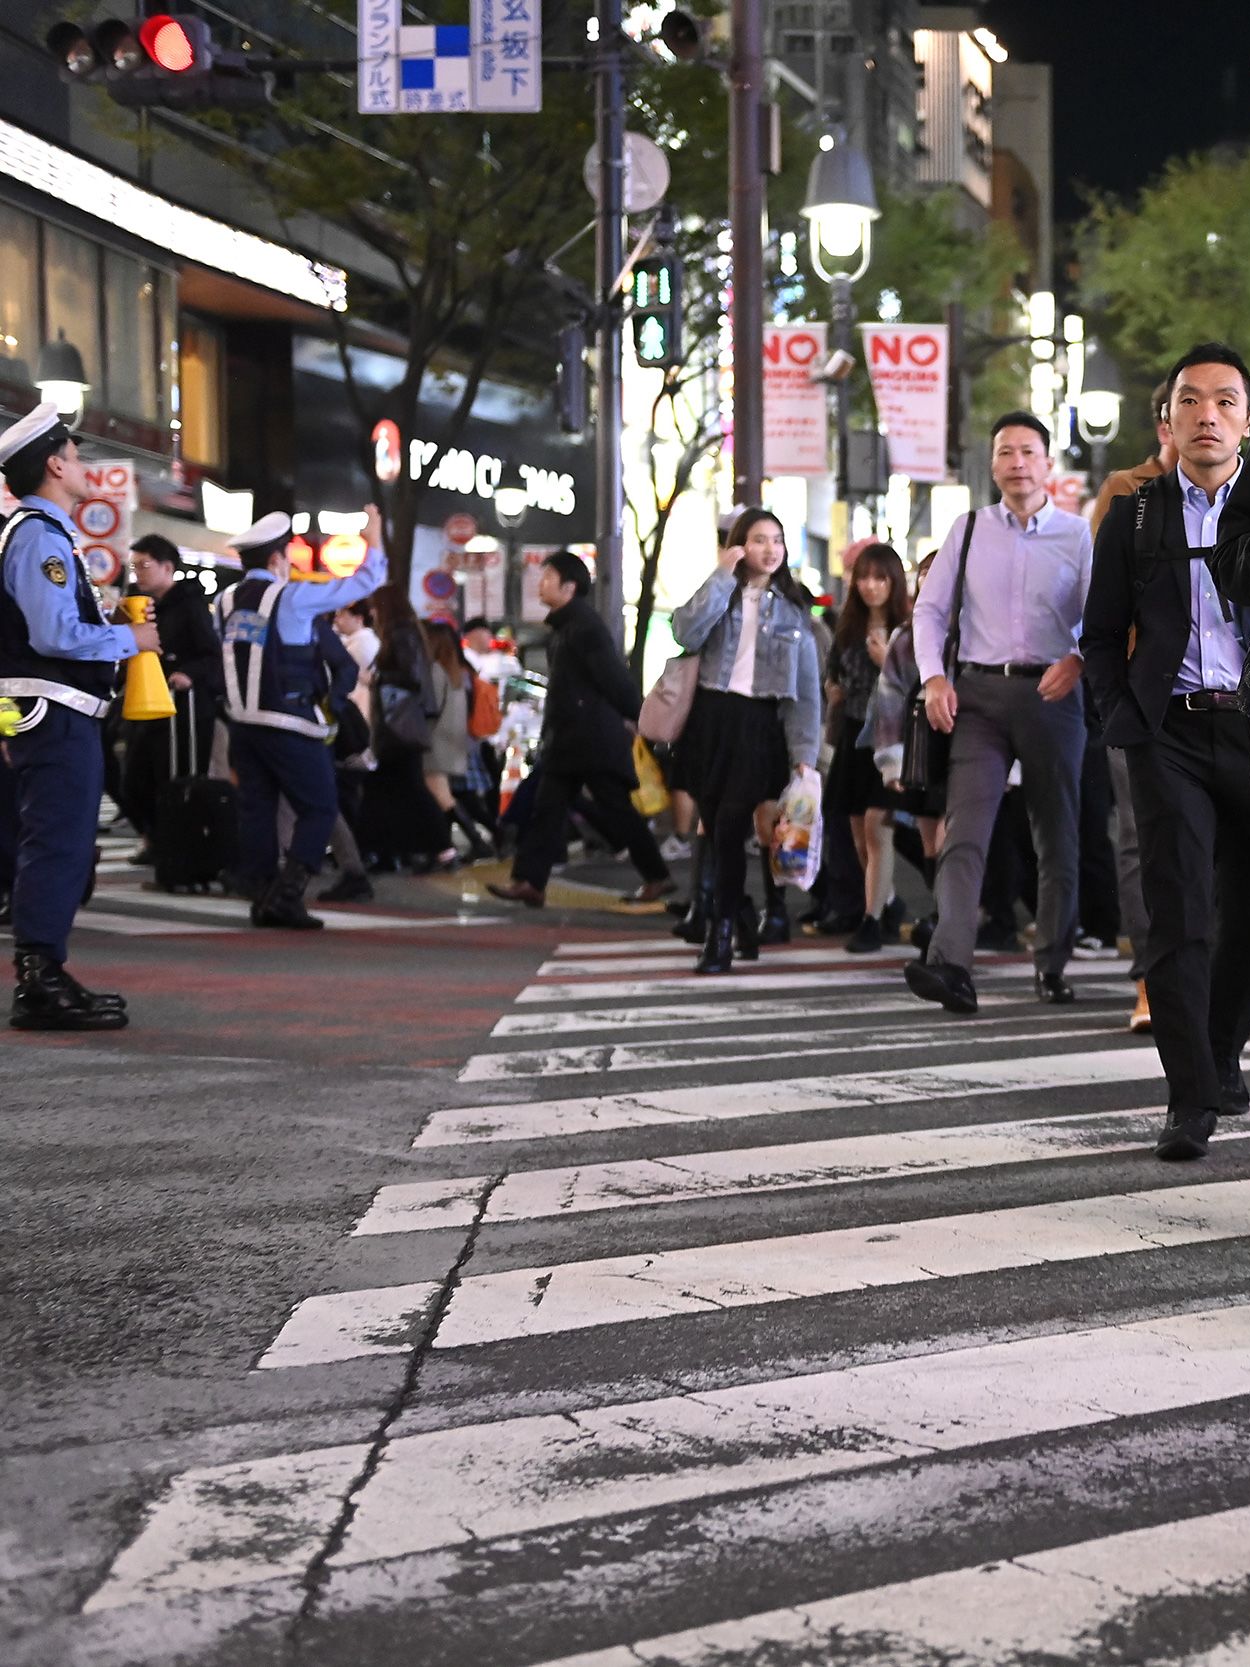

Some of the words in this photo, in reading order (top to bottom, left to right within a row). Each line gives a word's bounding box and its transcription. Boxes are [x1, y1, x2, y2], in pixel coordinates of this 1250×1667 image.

[871, 335, 939, 366] NO
[85, 468, 128, 487] NO
[1135, 498, 1147, 530] MILLET
